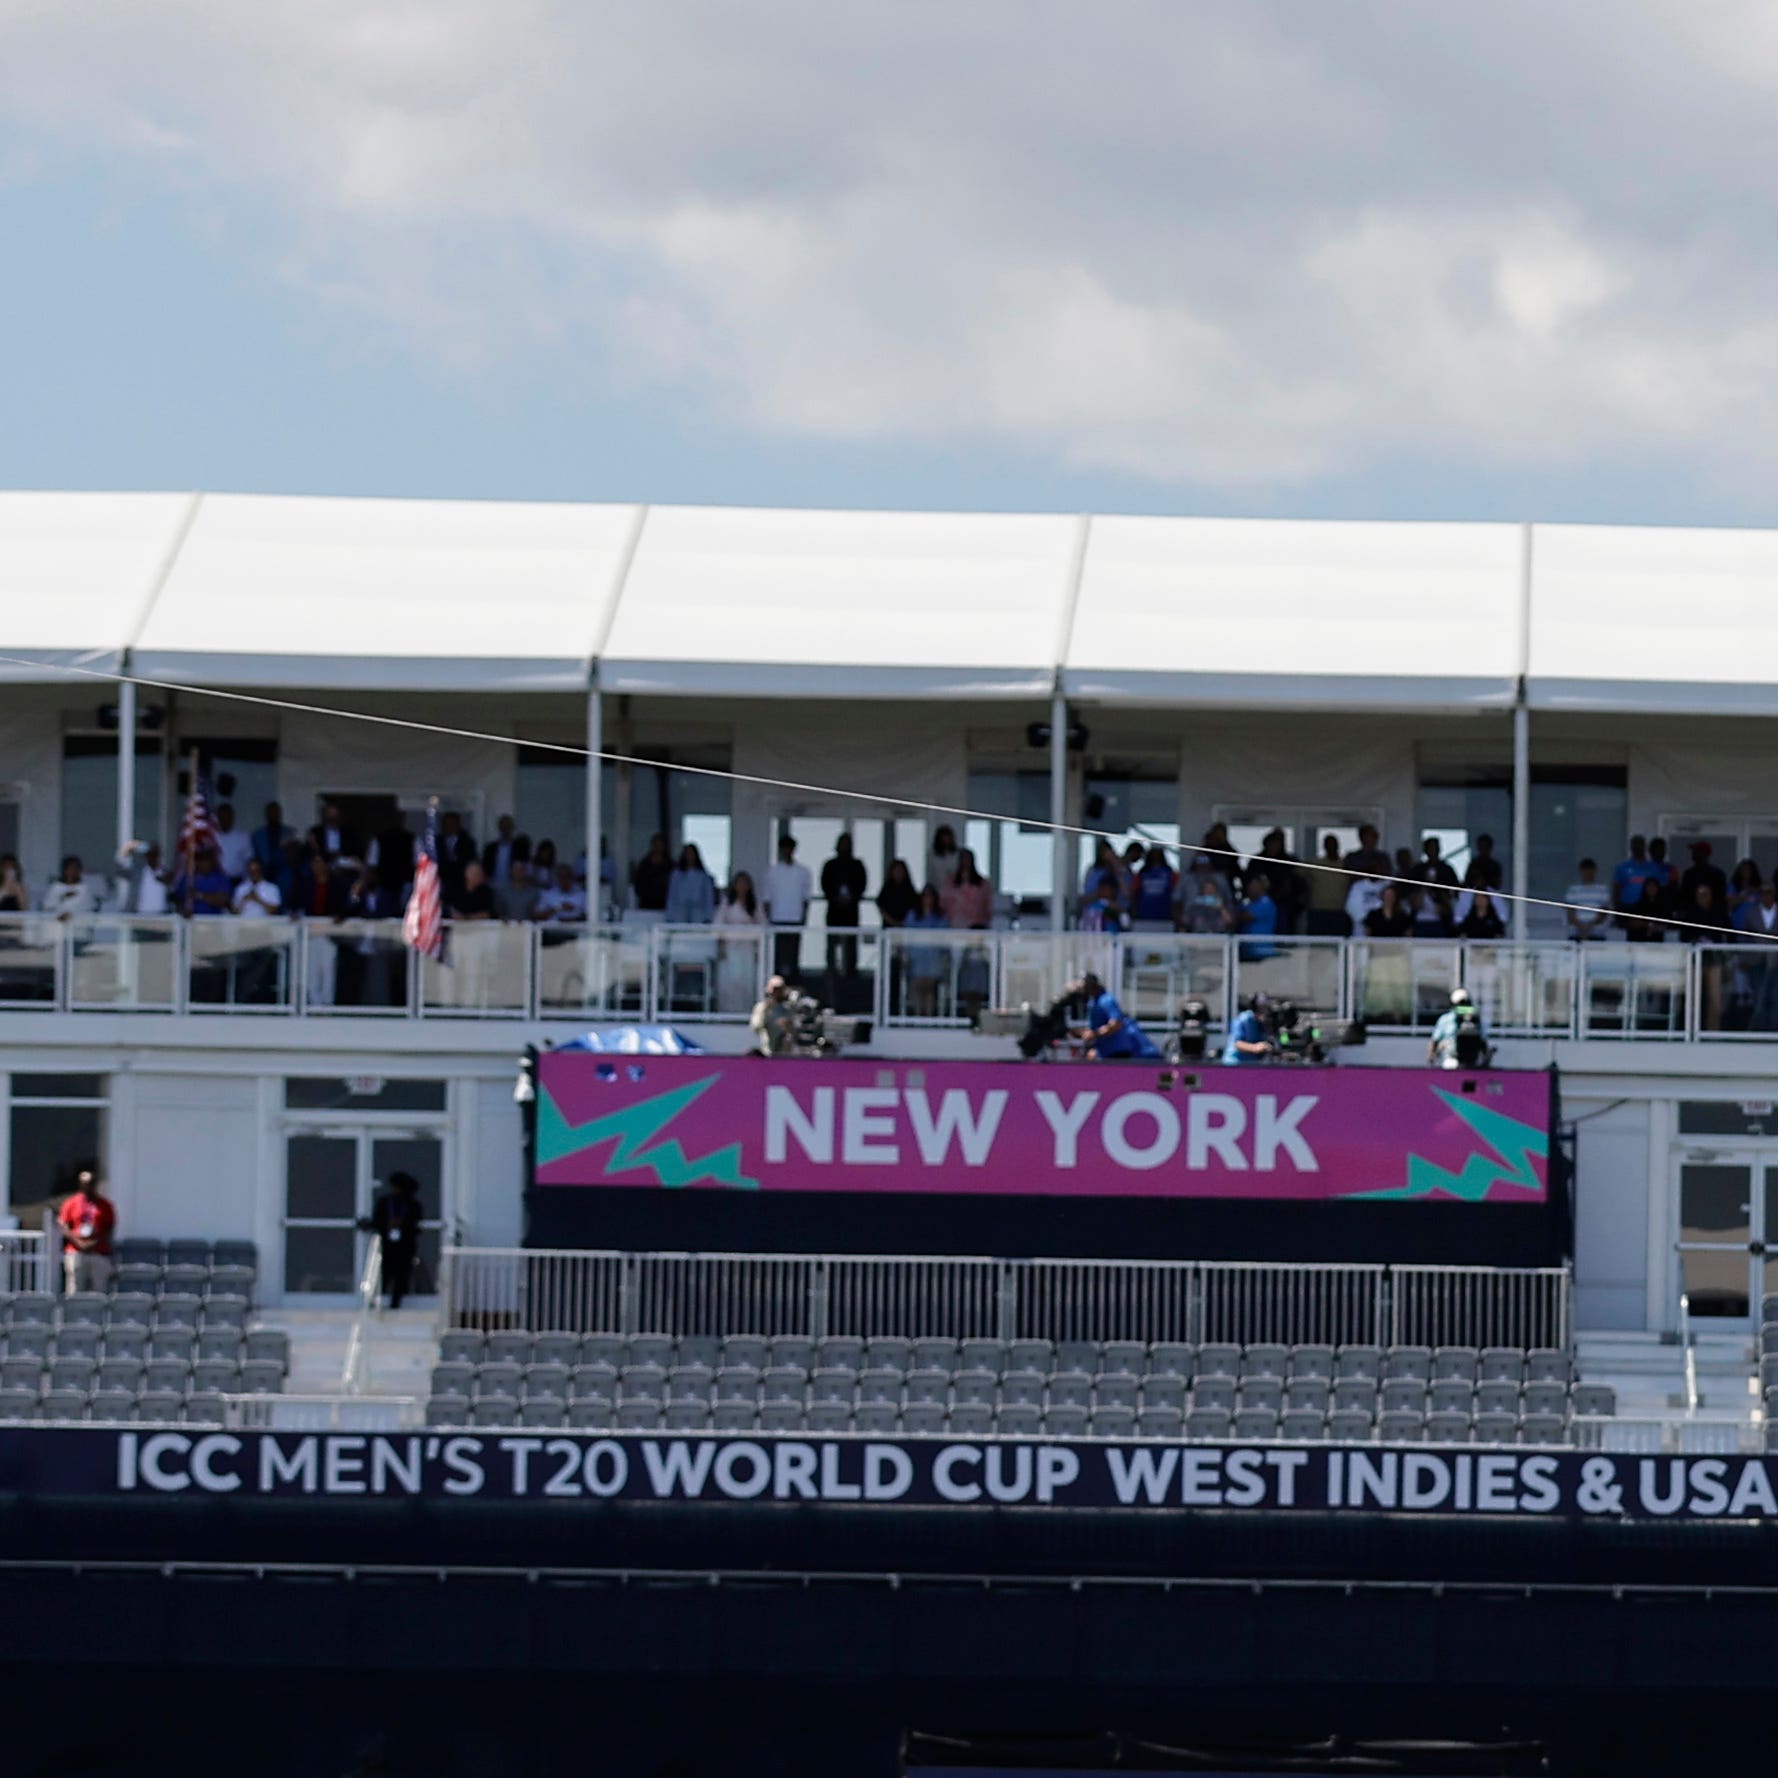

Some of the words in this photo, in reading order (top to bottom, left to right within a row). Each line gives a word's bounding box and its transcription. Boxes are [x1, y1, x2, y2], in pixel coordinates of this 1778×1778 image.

[763, 1087, 1008, 1167] NEW
[1034, 1090, 1319, 1173] YORK
[118, 1433, 241, 1490] ICC
[260, 1436, 484, 1494] MEN'S
[500, 1439, 627, 1496] T20
[641, 1441, 913, 1500] WORLD
[932, 1445, 1079, 1502] CUP
[1106, 1448, 1308, 1506] WEST
[1328, 1451, 1559, 1512] INDIES
[1576, 1458, 1624, 1515] &
[1639, 1459, 1778, 1516] USA
